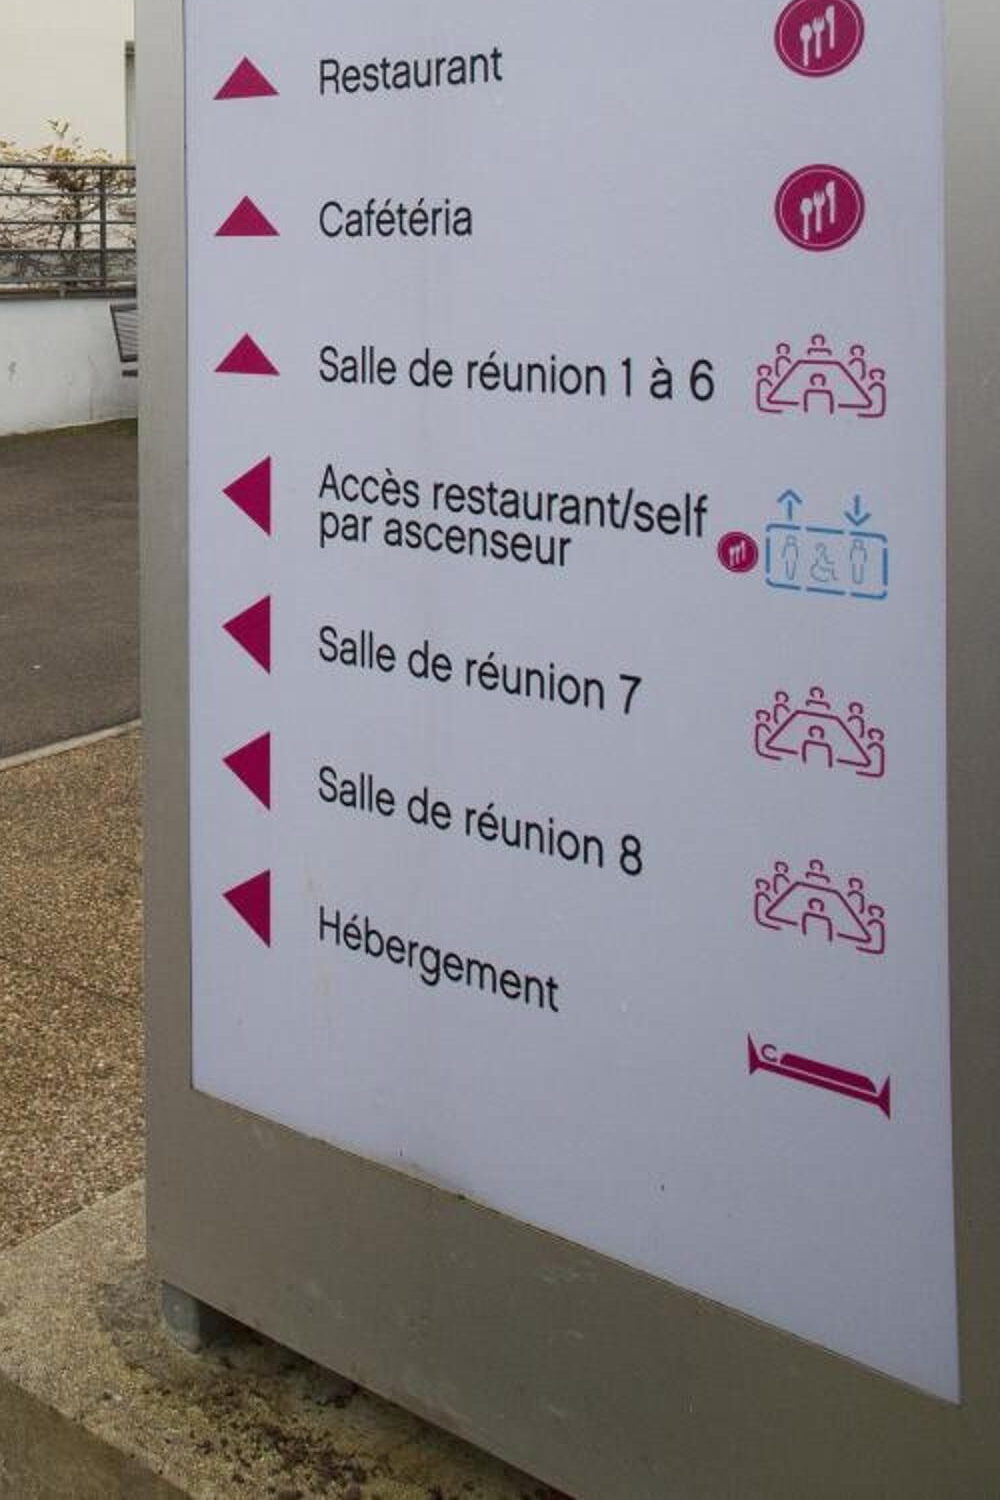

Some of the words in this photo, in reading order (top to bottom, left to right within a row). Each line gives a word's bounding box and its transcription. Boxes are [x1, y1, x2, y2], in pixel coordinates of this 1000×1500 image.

[319, 46, 503, 96] Restaurant
[319, 197, 473, 239] Cafétéria
[319, 345, 397, 386] Salle
[408, 347, 454, 389] de
[466, 350, 606, 397] réunion
[621, 356, 632, 398] 1
[649, 355, 673, 400] à
[689, 358, 715, 402] 6
[318, 463, 421, 509] Accès
[432, 481, 709, 538] restaurant/self
[319, 510, 373, 549] par
[383, 517, 573, 567] ascenseur
[318, 625, 397, 673] Salle
[407, 639, 453, 683] de
[465, 651, 605, 711] réunion
[618, 673, 643, 715] 7
[318, 765, 396, 817] Salle
[407, 786, 452, 831] de
[465, 802, 604, 869] réunion
[619, 833, 643, 877] 8
[319, 905, 559, 1013] Hébergement
